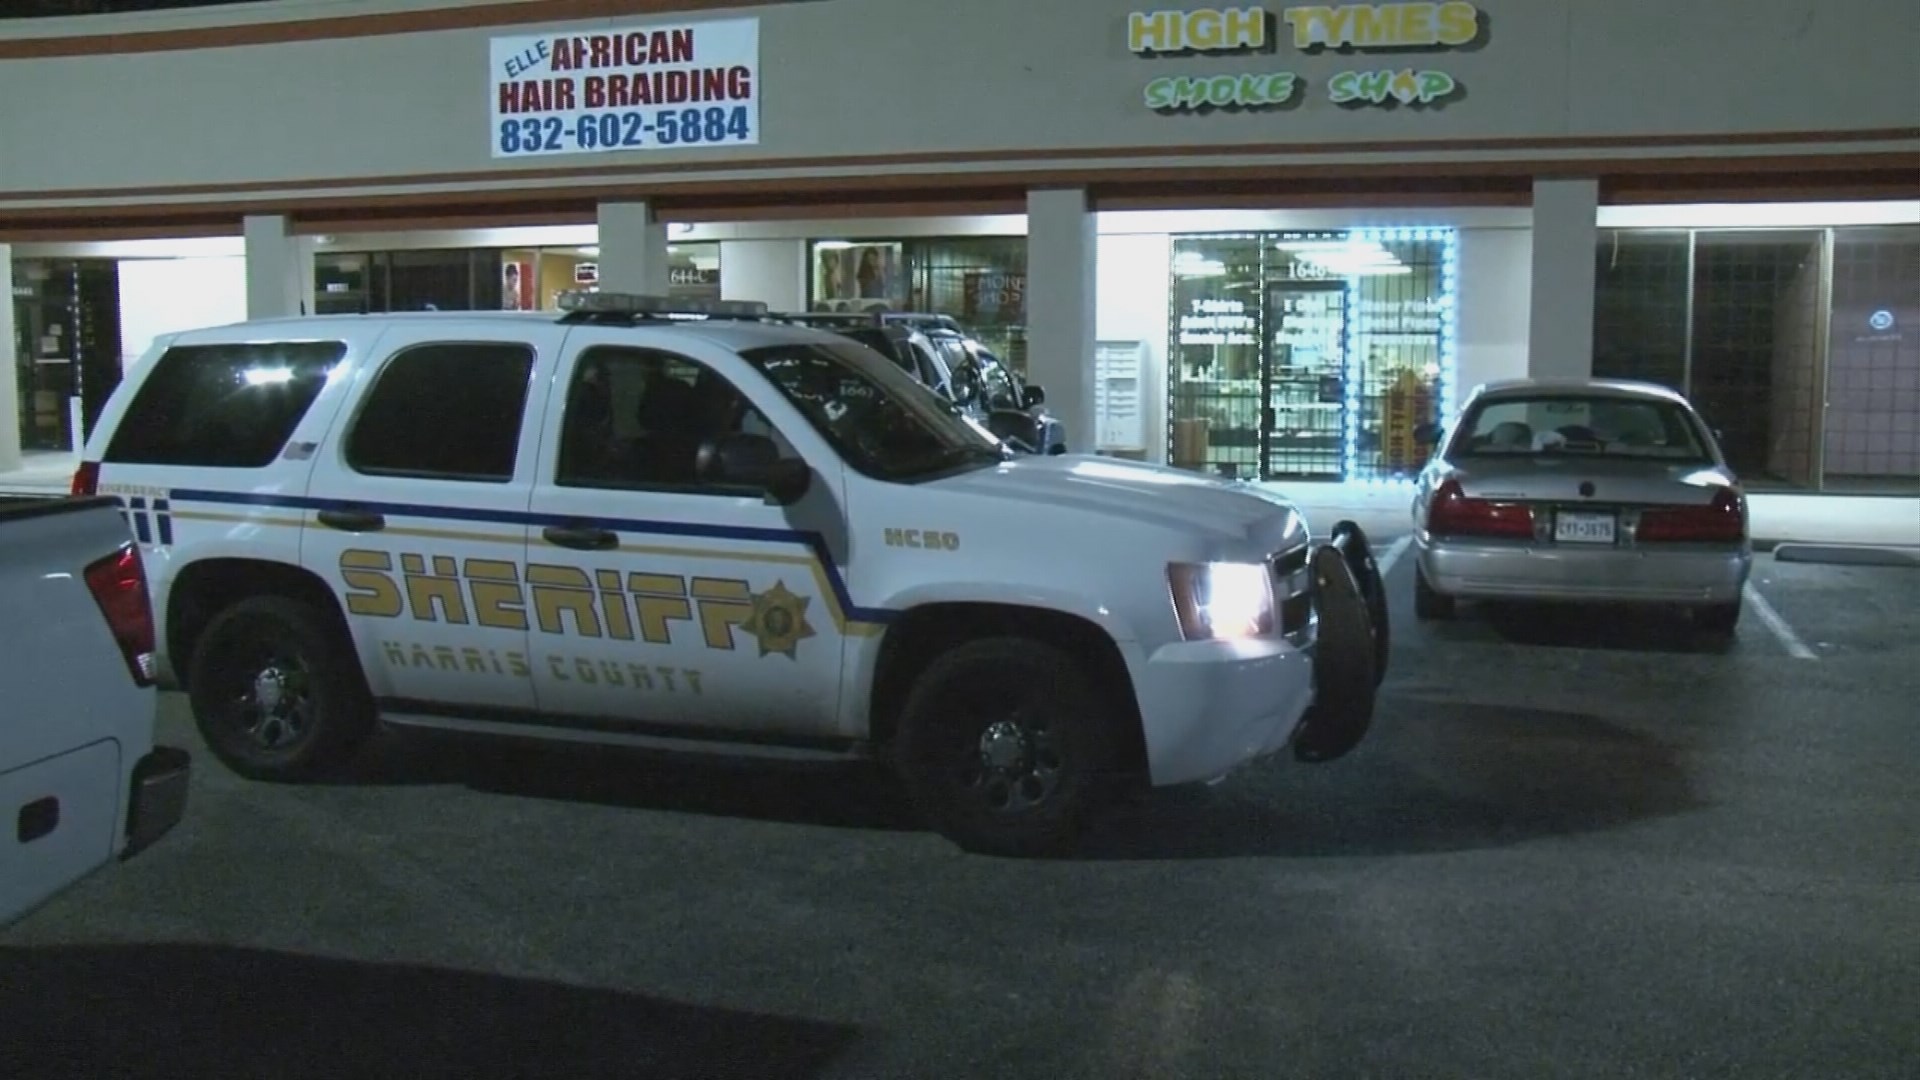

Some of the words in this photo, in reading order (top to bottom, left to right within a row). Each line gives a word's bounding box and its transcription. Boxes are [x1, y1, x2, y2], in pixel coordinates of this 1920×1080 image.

[551, 28, 694, 72] AFRICAN
[1128, 7, 1265, 52] HIGH
[1285, 1, 1478, 49] TYMES
[503, 39, 550, 79] ELLE
[499, 77, 575, 114] HAIR
[584, 65, 751, 109] BRAIDING
[1144, 71, 1296, 109] SMOKE
[1328, 68, 1455, 105] SHOP
[500, 105, 749, 154] 832-602-5884
[339, 547, 752, 651] SHERIFF
[383, 639, 532, 678] HARRIS
[547, 653, 704, 695] COUNTY
